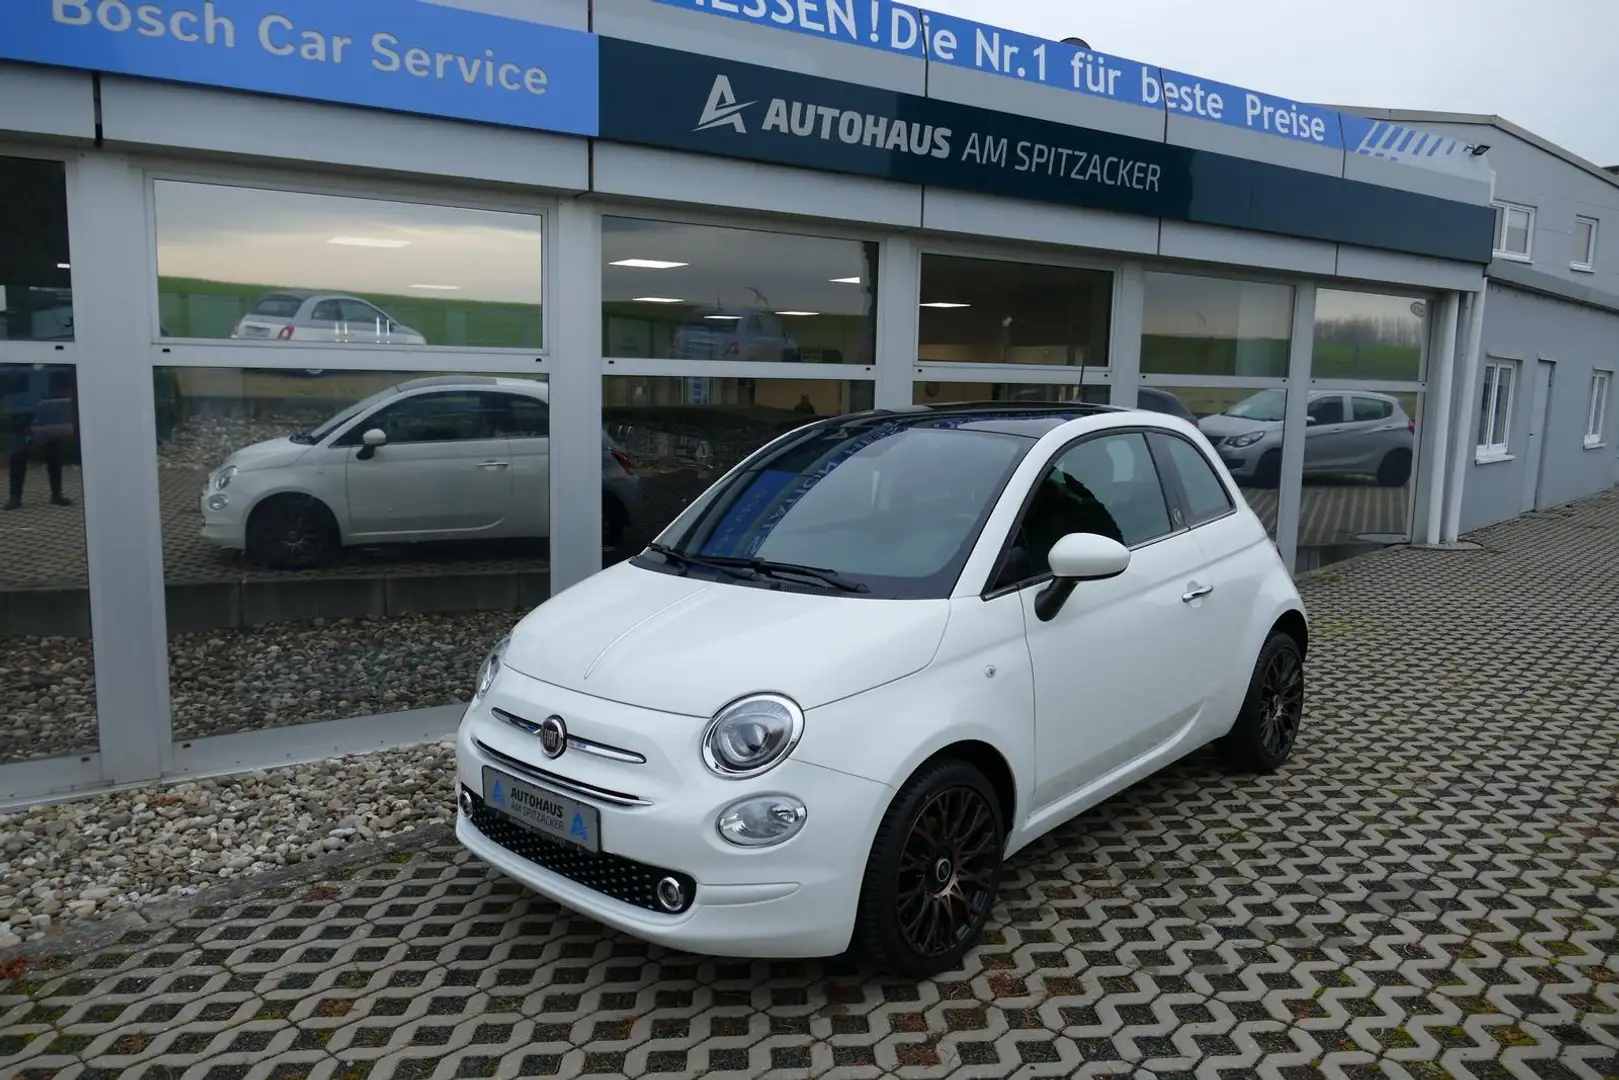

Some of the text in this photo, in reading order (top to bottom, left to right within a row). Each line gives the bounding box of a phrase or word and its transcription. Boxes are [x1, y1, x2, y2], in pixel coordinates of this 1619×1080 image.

[52, 0, 549, 95] Bosch Car Service
[890, 8, 958, 60] Die
[1070, 51, 1121, 95] für
[1141, 66, 1223, 119] beste
[1245, 94, 1326, 141] Preise
[761, 98, 952, 158] AUTOHAUS
[961, 132, 1008, 167] AM
[1014, 140, 1162, 192] SPITZACKER
[510, 787, 564, 818] AUTOHAUS
[522, 805, 565, 831] SPITZACKER
